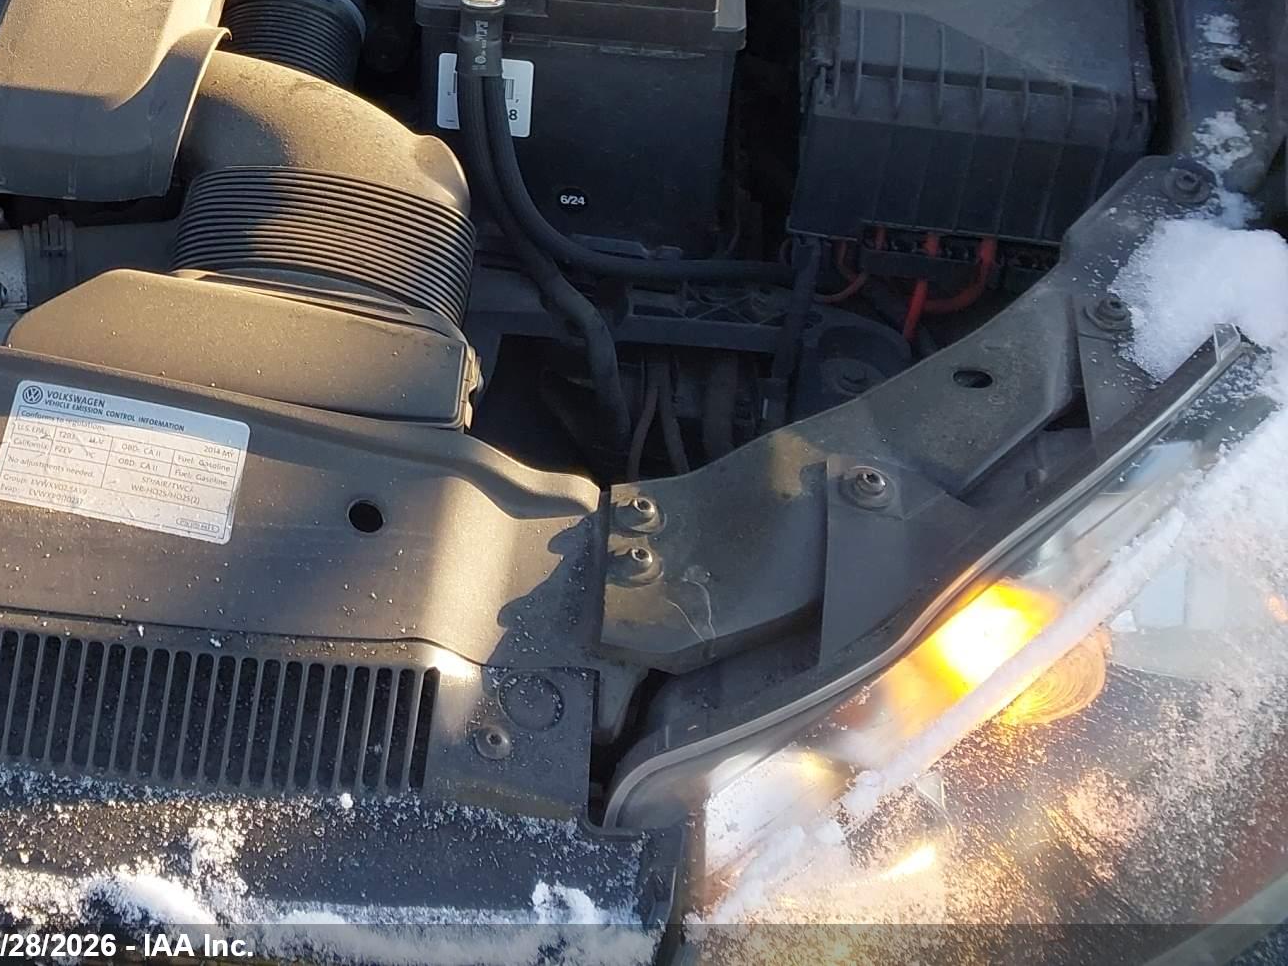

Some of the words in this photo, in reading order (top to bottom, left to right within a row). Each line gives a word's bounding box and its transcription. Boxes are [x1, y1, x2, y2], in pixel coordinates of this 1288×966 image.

[560, 194, 586, 206] 6/24
[46, 389, 105, 408] VOLKSWAGEN
[20, 409, 55, 422] Conforms
[43, 398, 70, 409] VEHICLE
[71, 403, 103, 415] EMISSION
[105, 409, 136, 421] CONTROL
[137, 415, 185, 431] INFORMATION
[203, 445, 221, 455] 2014
[7, 454, 19, 463] No
[197, 459, 231, 472] Gasoline
[194, 473, 228, 486] Gasoline
